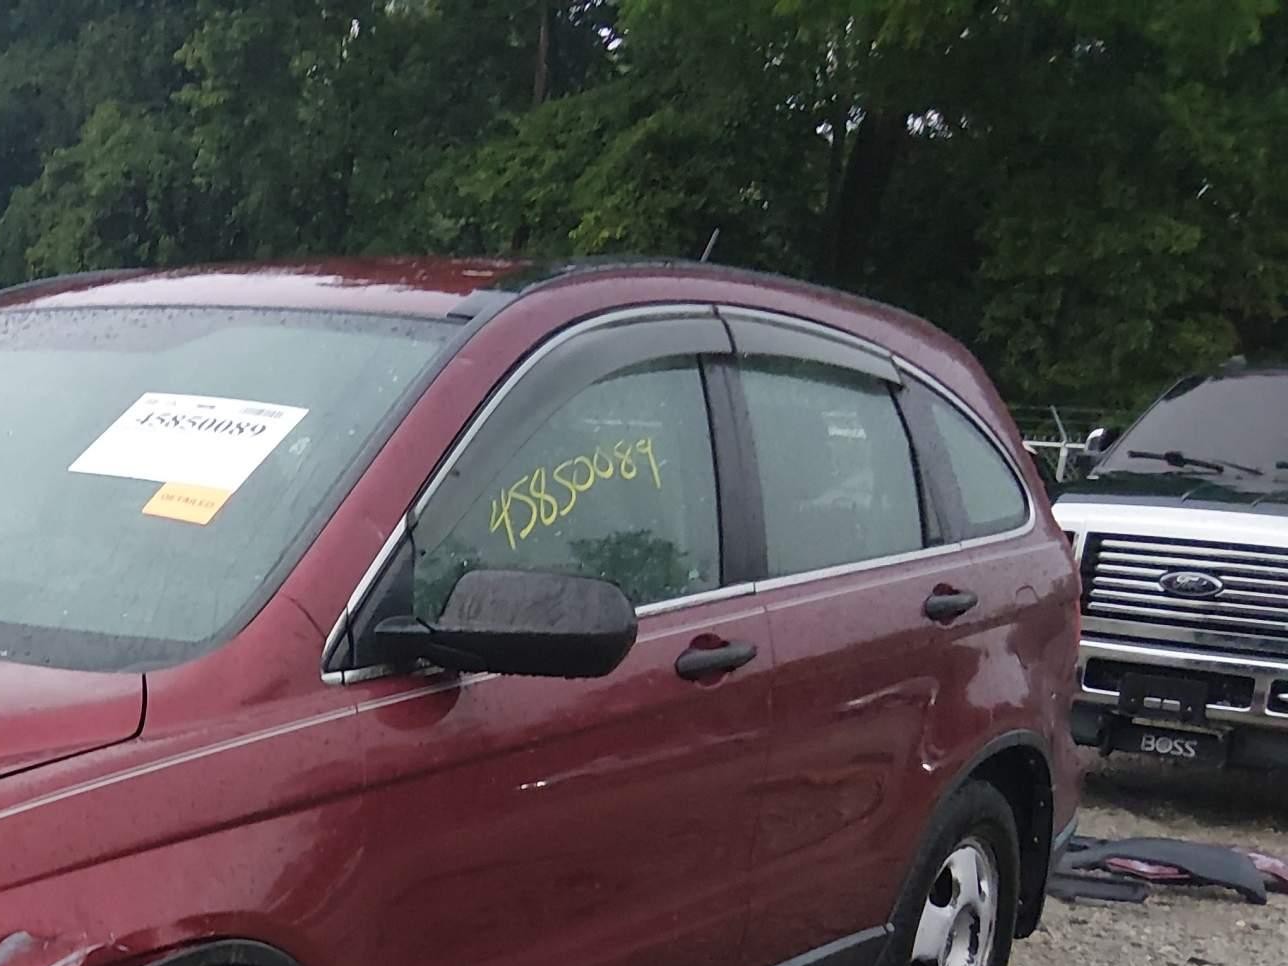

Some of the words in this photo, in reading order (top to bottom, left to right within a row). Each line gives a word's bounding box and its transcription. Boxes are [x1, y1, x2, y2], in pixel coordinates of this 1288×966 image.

[137, 411, 266, 436] 45850089
[489, 438, 661, 549] 45850089
[1141, 735, 1198, 758] BOSS
